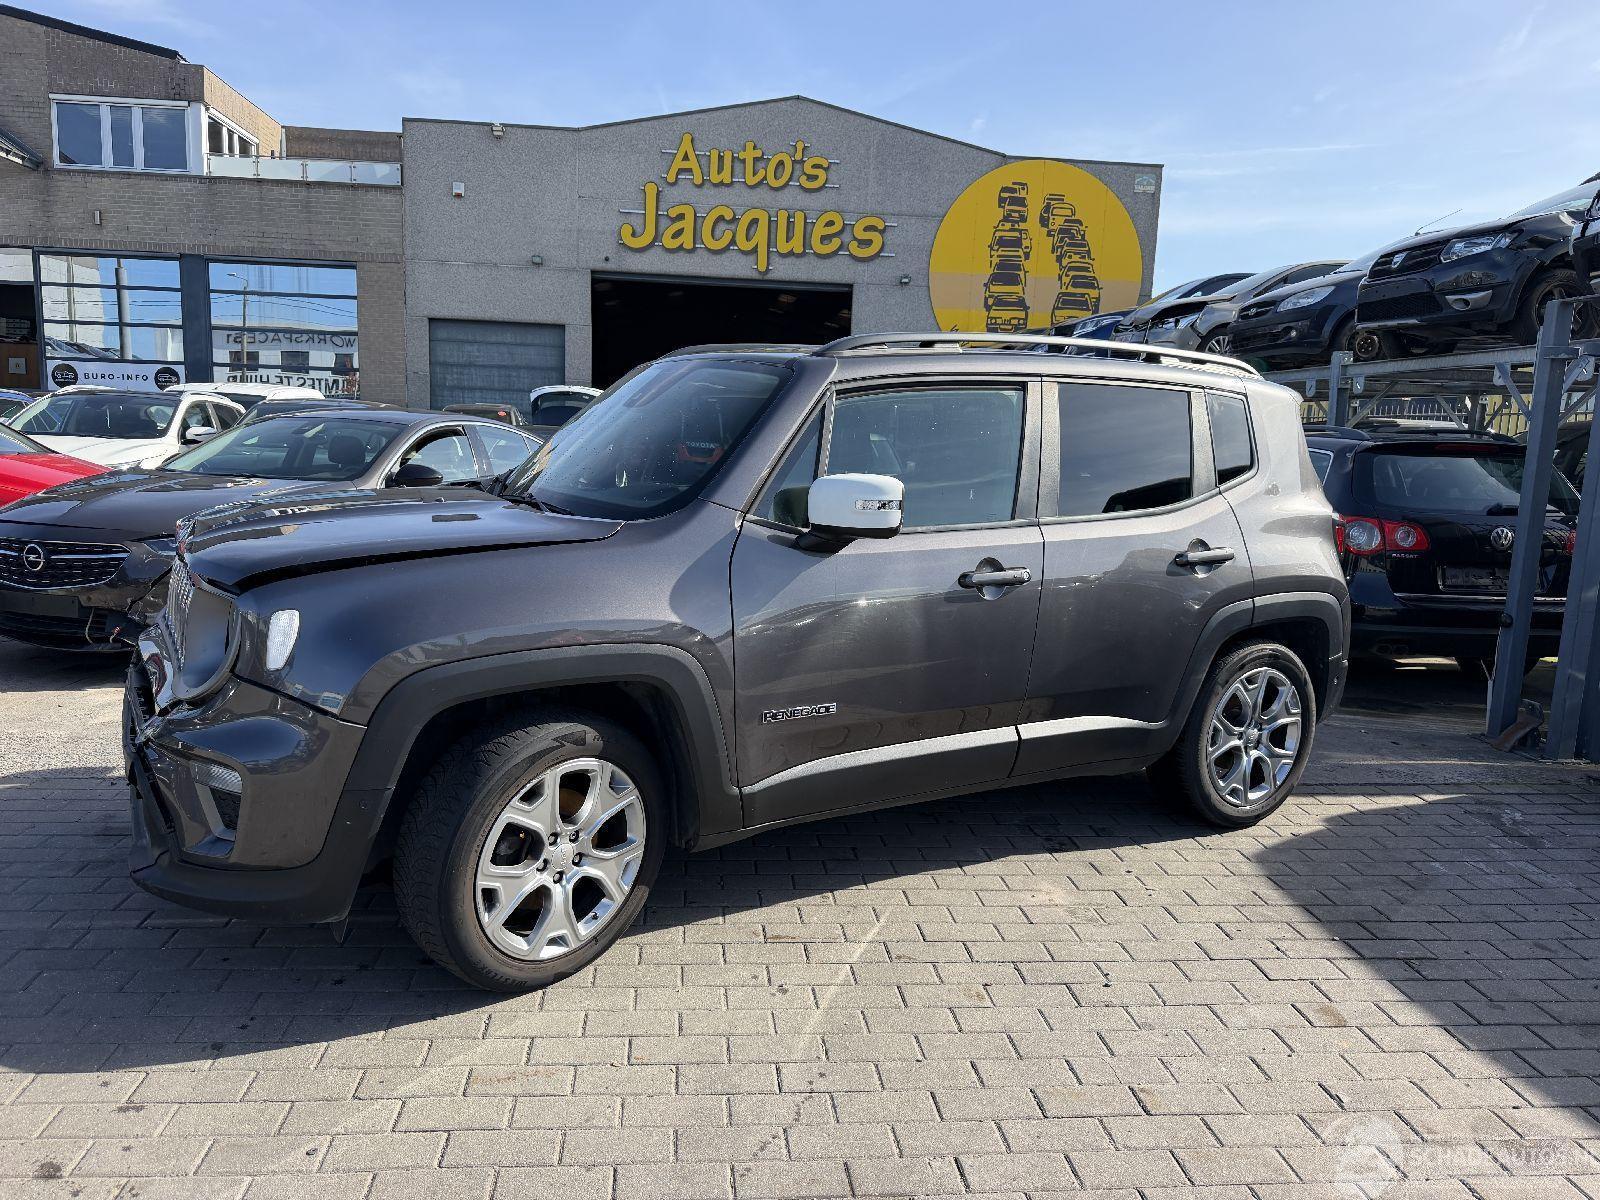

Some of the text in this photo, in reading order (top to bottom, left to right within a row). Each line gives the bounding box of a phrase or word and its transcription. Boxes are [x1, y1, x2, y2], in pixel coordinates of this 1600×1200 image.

[666, 132, 830, 190] Auto's
[620, 182, 887, 273] Jacques
[83, 372, 149, 382] BURO-INFO
[686, 441, 716, 449] TOYOTA
[762, 702, 837, 724] RENEGADE
